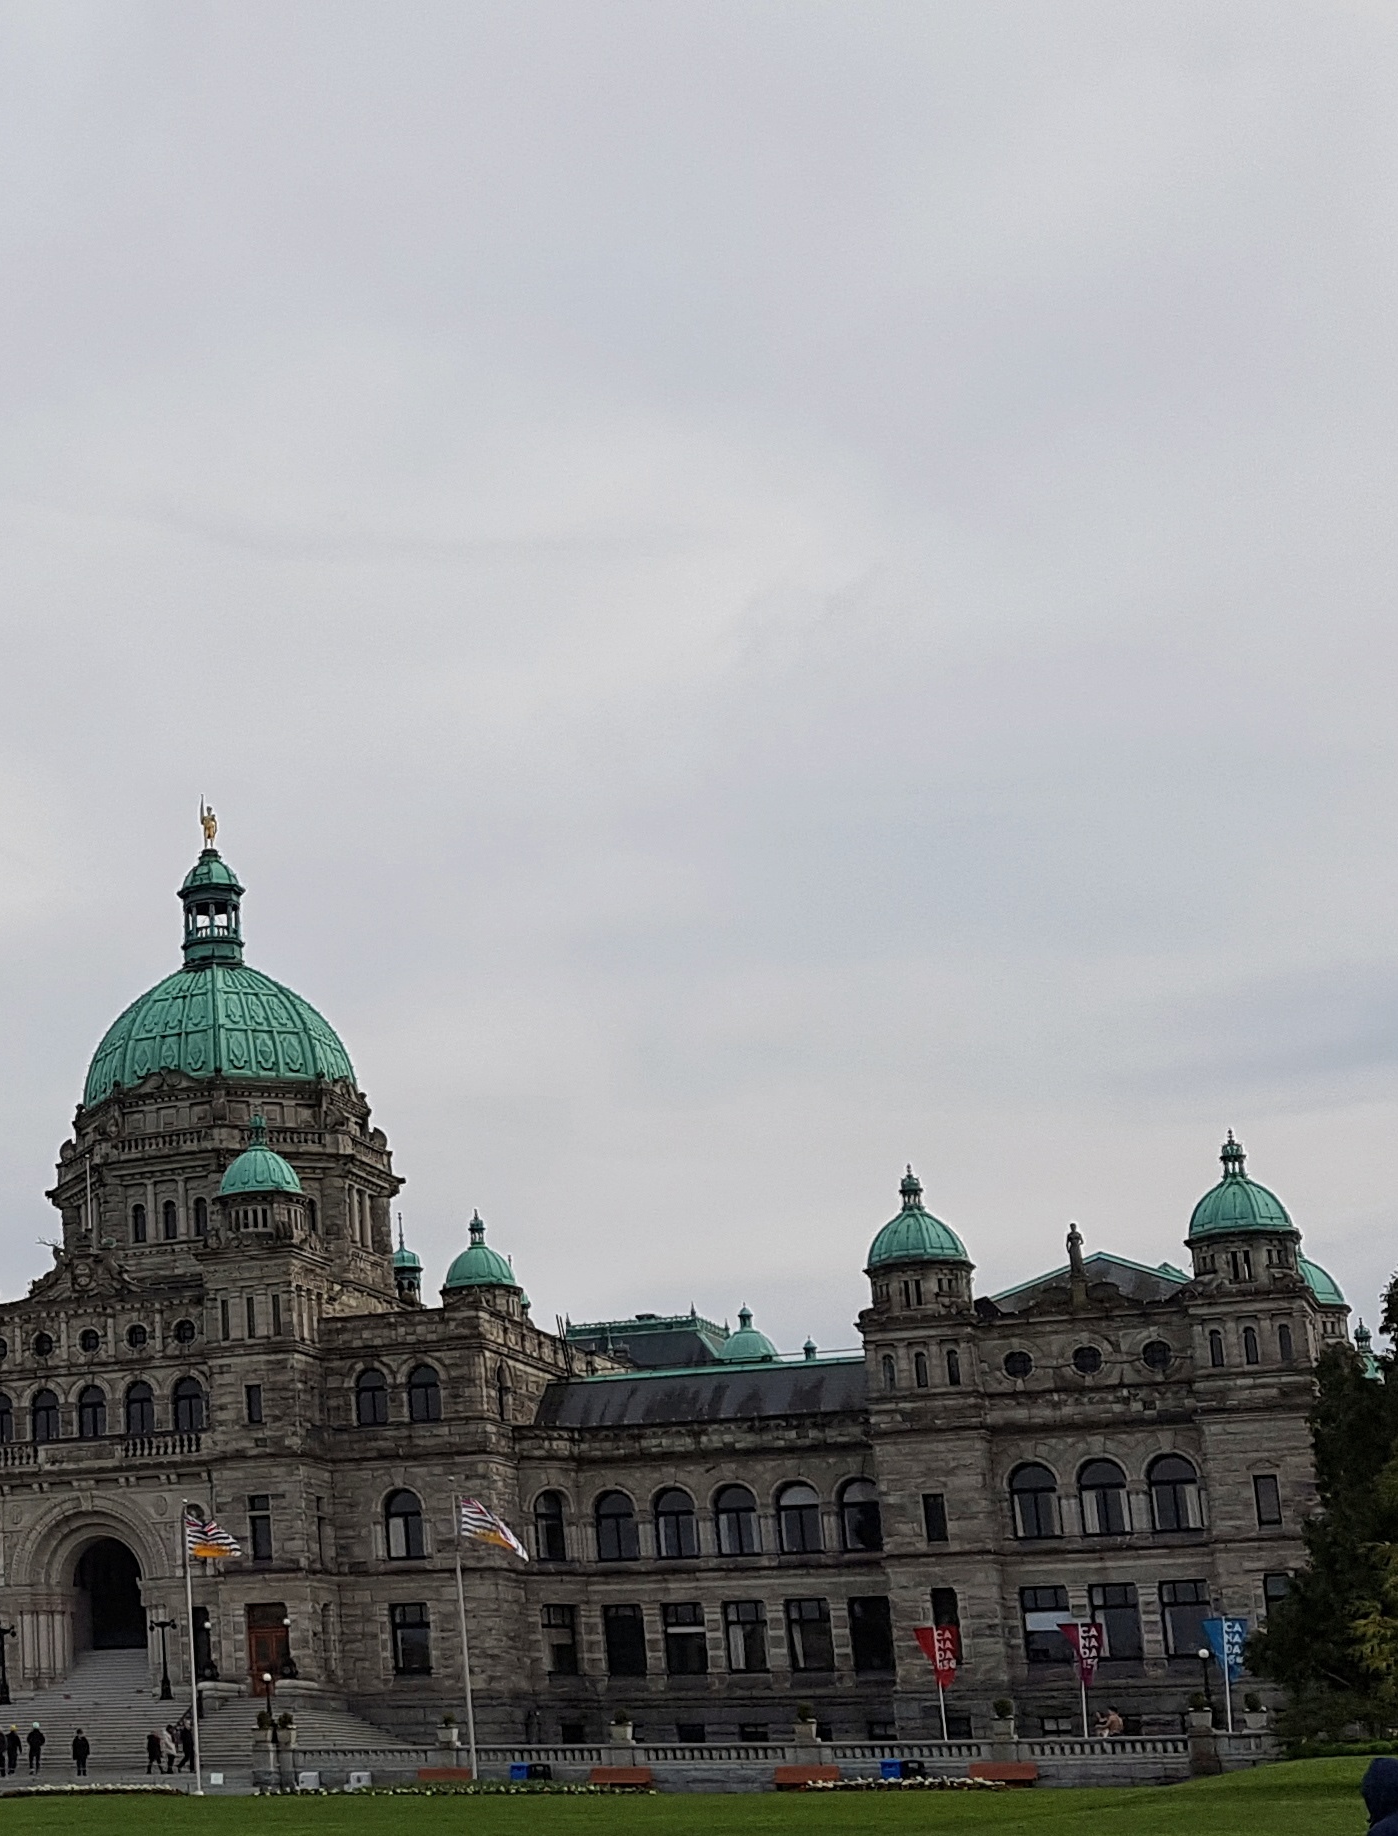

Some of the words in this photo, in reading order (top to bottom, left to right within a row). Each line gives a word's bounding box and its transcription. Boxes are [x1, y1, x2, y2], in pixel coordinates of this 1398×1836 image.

[1081, 1627, 1098, 1637] CA
[1224, 1622, 1242, 1632] CA
[935, 1630, 952, 1640] CA
[1224, 1633, 1242, 1643] NA
[936, 1640, 954, 1650] NA
[1081, 1637, 1099, 1648] NA
[1082, 1648, 1098, 1658] DA
[1225, 1644, 1241, 1654] DA
[938, 1650, 954, 1660] DA
